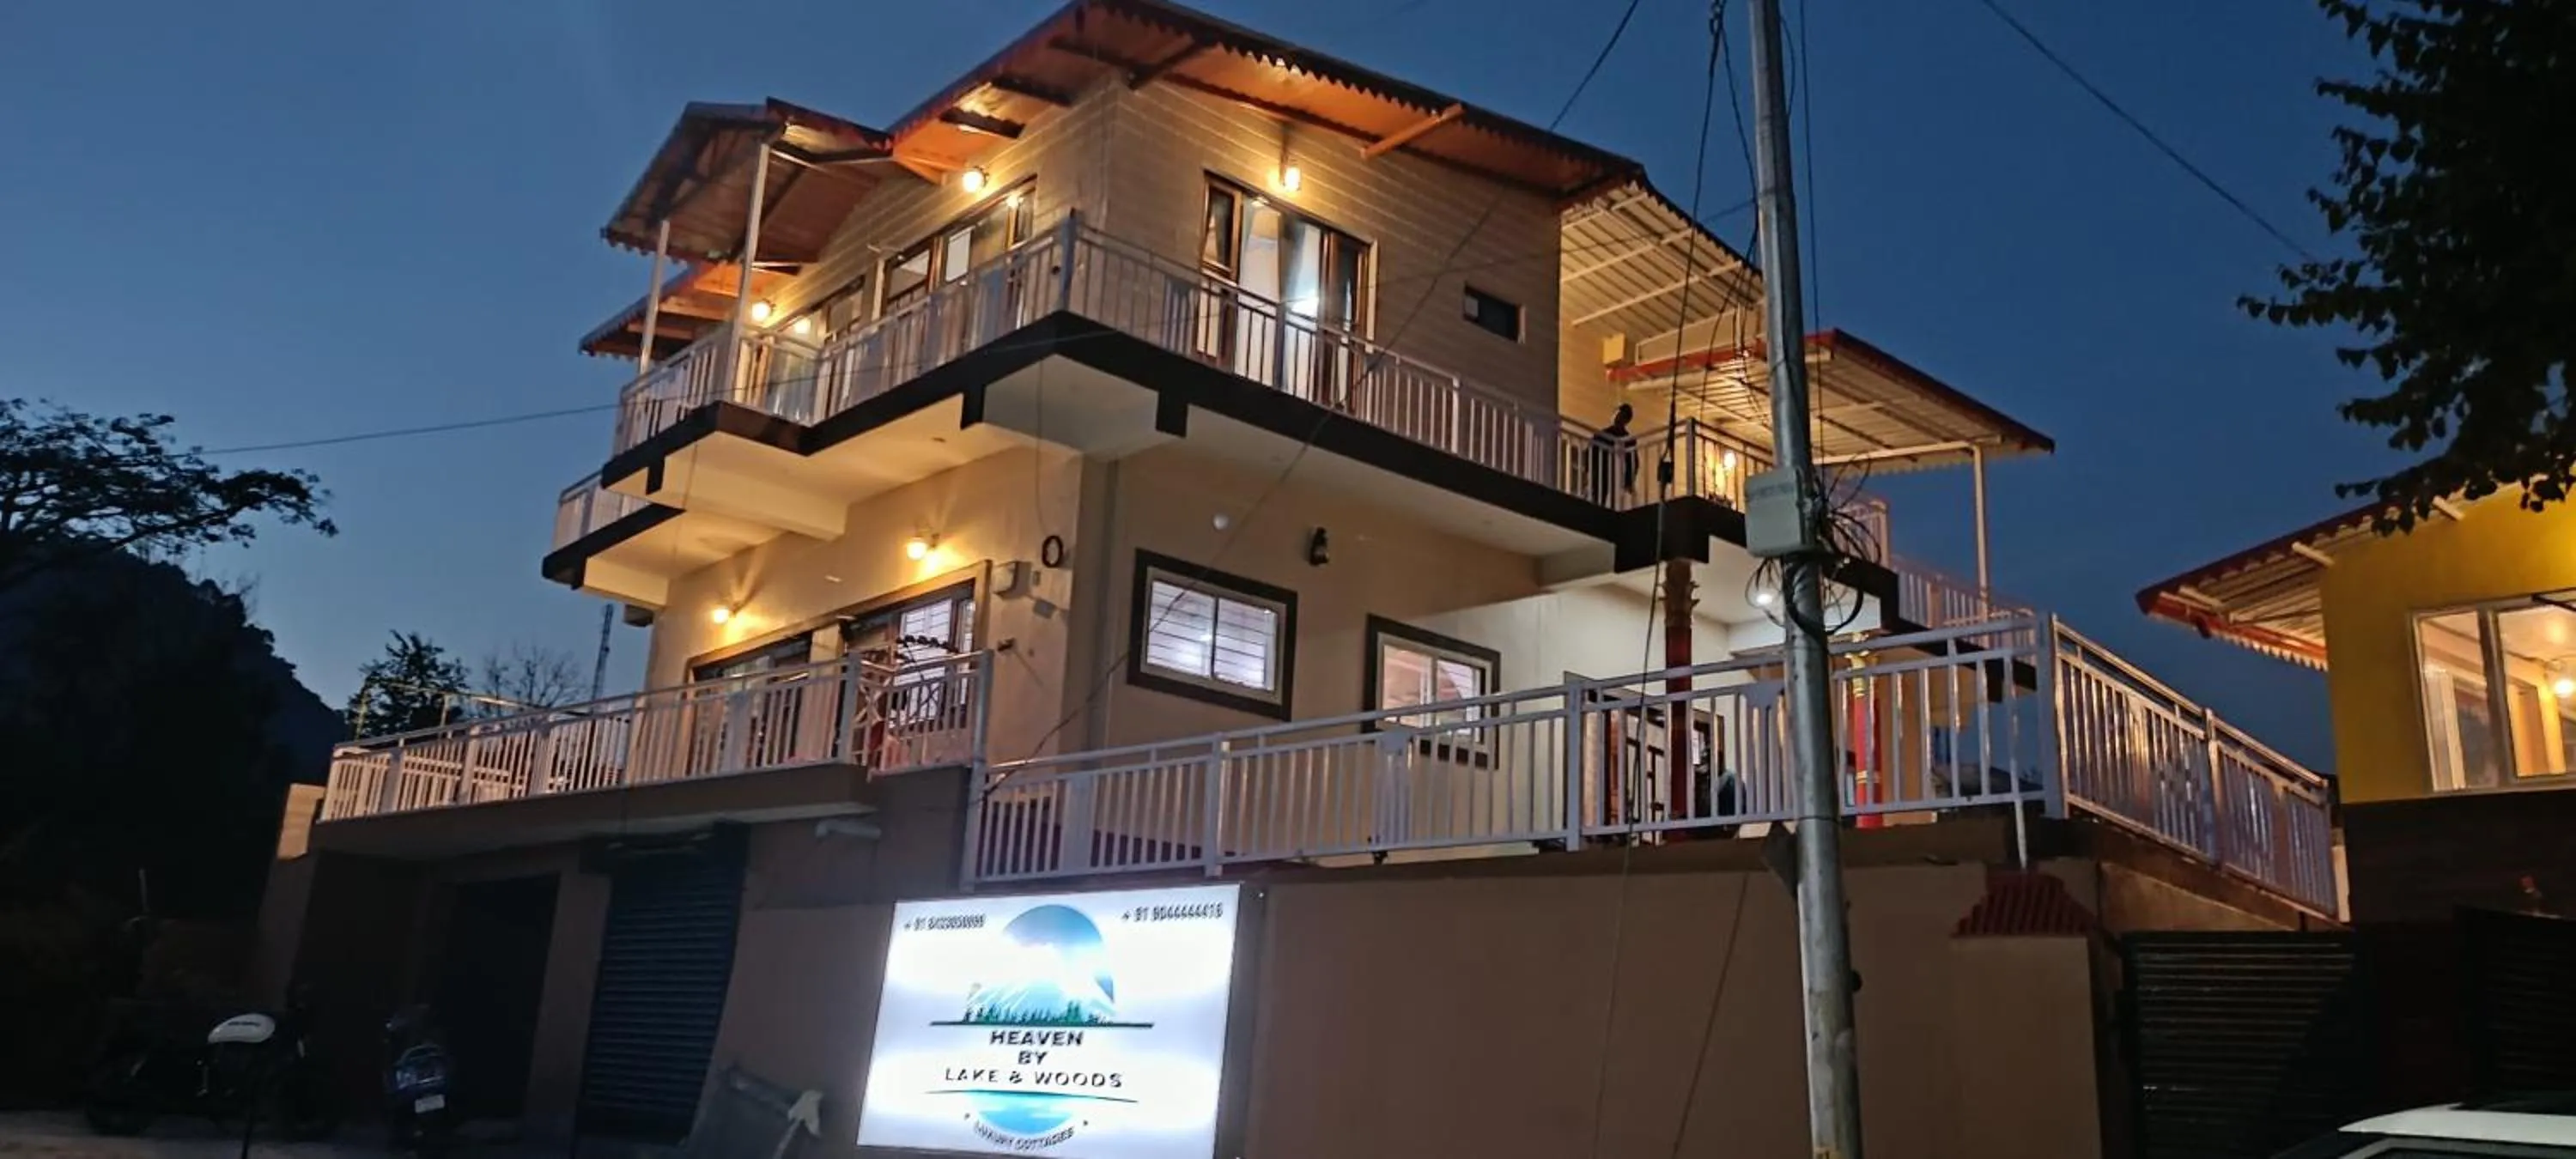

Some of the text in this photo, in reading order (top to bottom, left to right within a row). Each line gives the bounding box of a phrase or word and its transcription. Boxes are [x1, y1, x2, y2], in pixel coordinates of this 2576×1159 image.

[989, 1030, 1084, 1047] HEAVEN
[1018, 1050, 1048, 1065] BY
[945, 1068, 999, 1083] LAKE
[1035, 1071, 1122, 1088] WOODS
